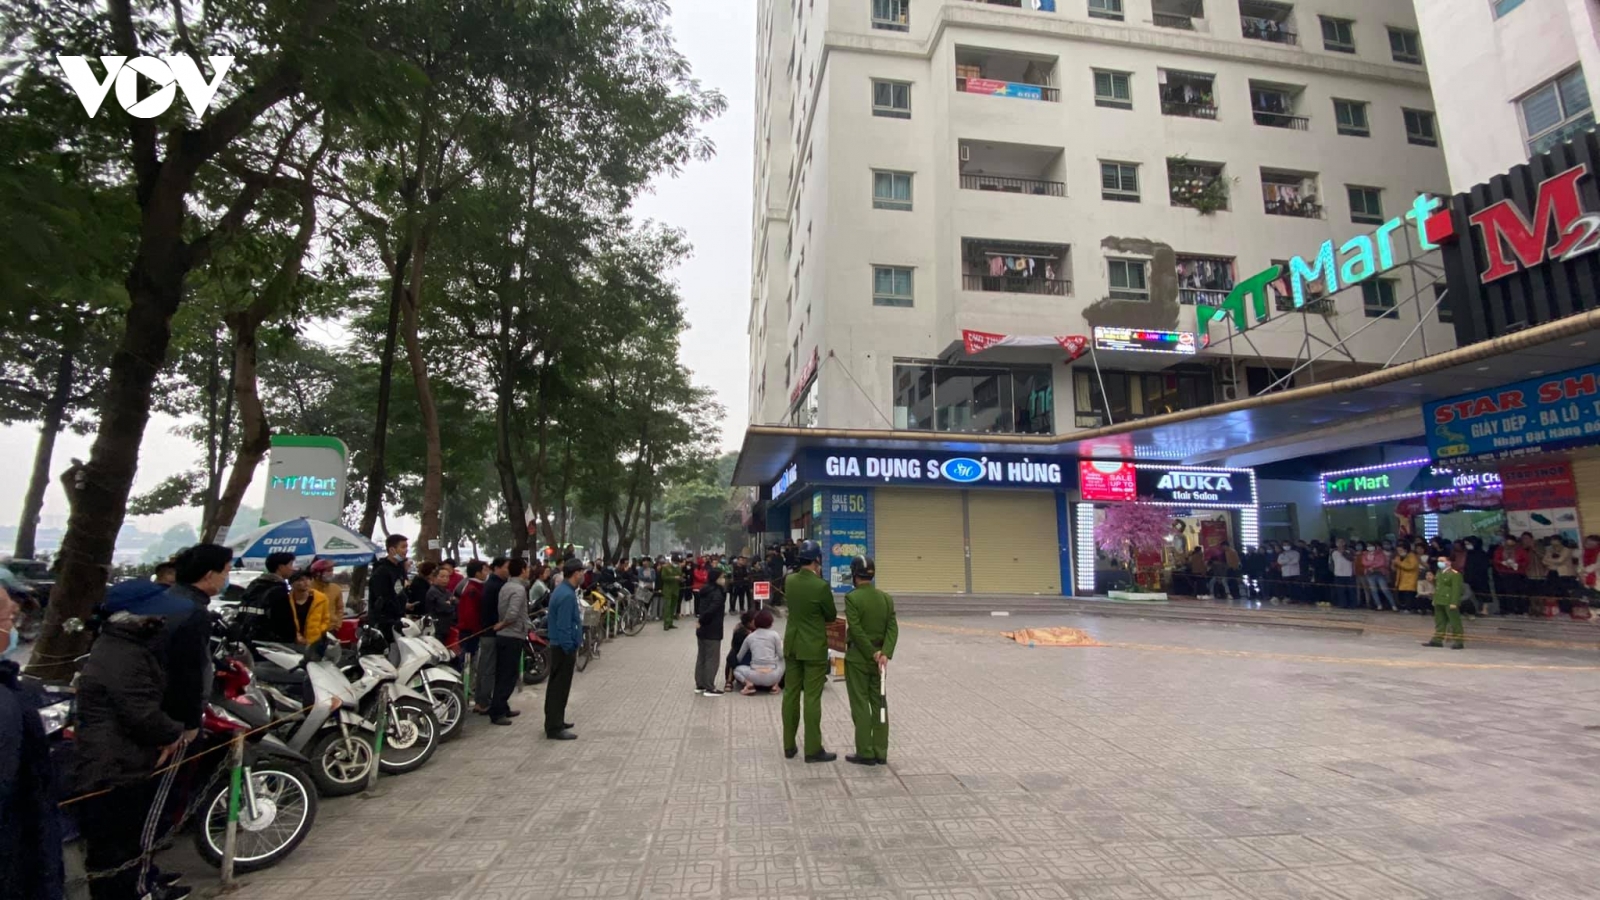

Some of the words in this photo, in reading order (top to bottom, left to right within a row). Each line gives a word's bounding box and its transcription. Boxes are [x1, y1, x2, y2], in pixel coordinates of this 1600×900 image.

[1289, 193, 1440, 309] Mart
[1434, 389, 1527, 424] STAR
[1538, 373, 1600, 403] SH
[1471, 419, 1498, 438] GIÀY
[1539, 409, 1559, 426] BA
[1562, 402, 1580, 421] LÔ
[826, 456, 860, 477] GIA
[866, 457, 921, 481] DỤNG
[1008, 458, 1062, 483] HÙNG
[301, 475, 337, 490] Mart
[1157, 471, 1233, 491] ATUKA
[1354, 474, 1390, 491] Mart
[1453, 474, 1479, 487] KÍNH
[832, 494, 847, 504] SALE
[1172, 491, 1191, 500] Hair
[1193, 491, 1218, 500] Salon
